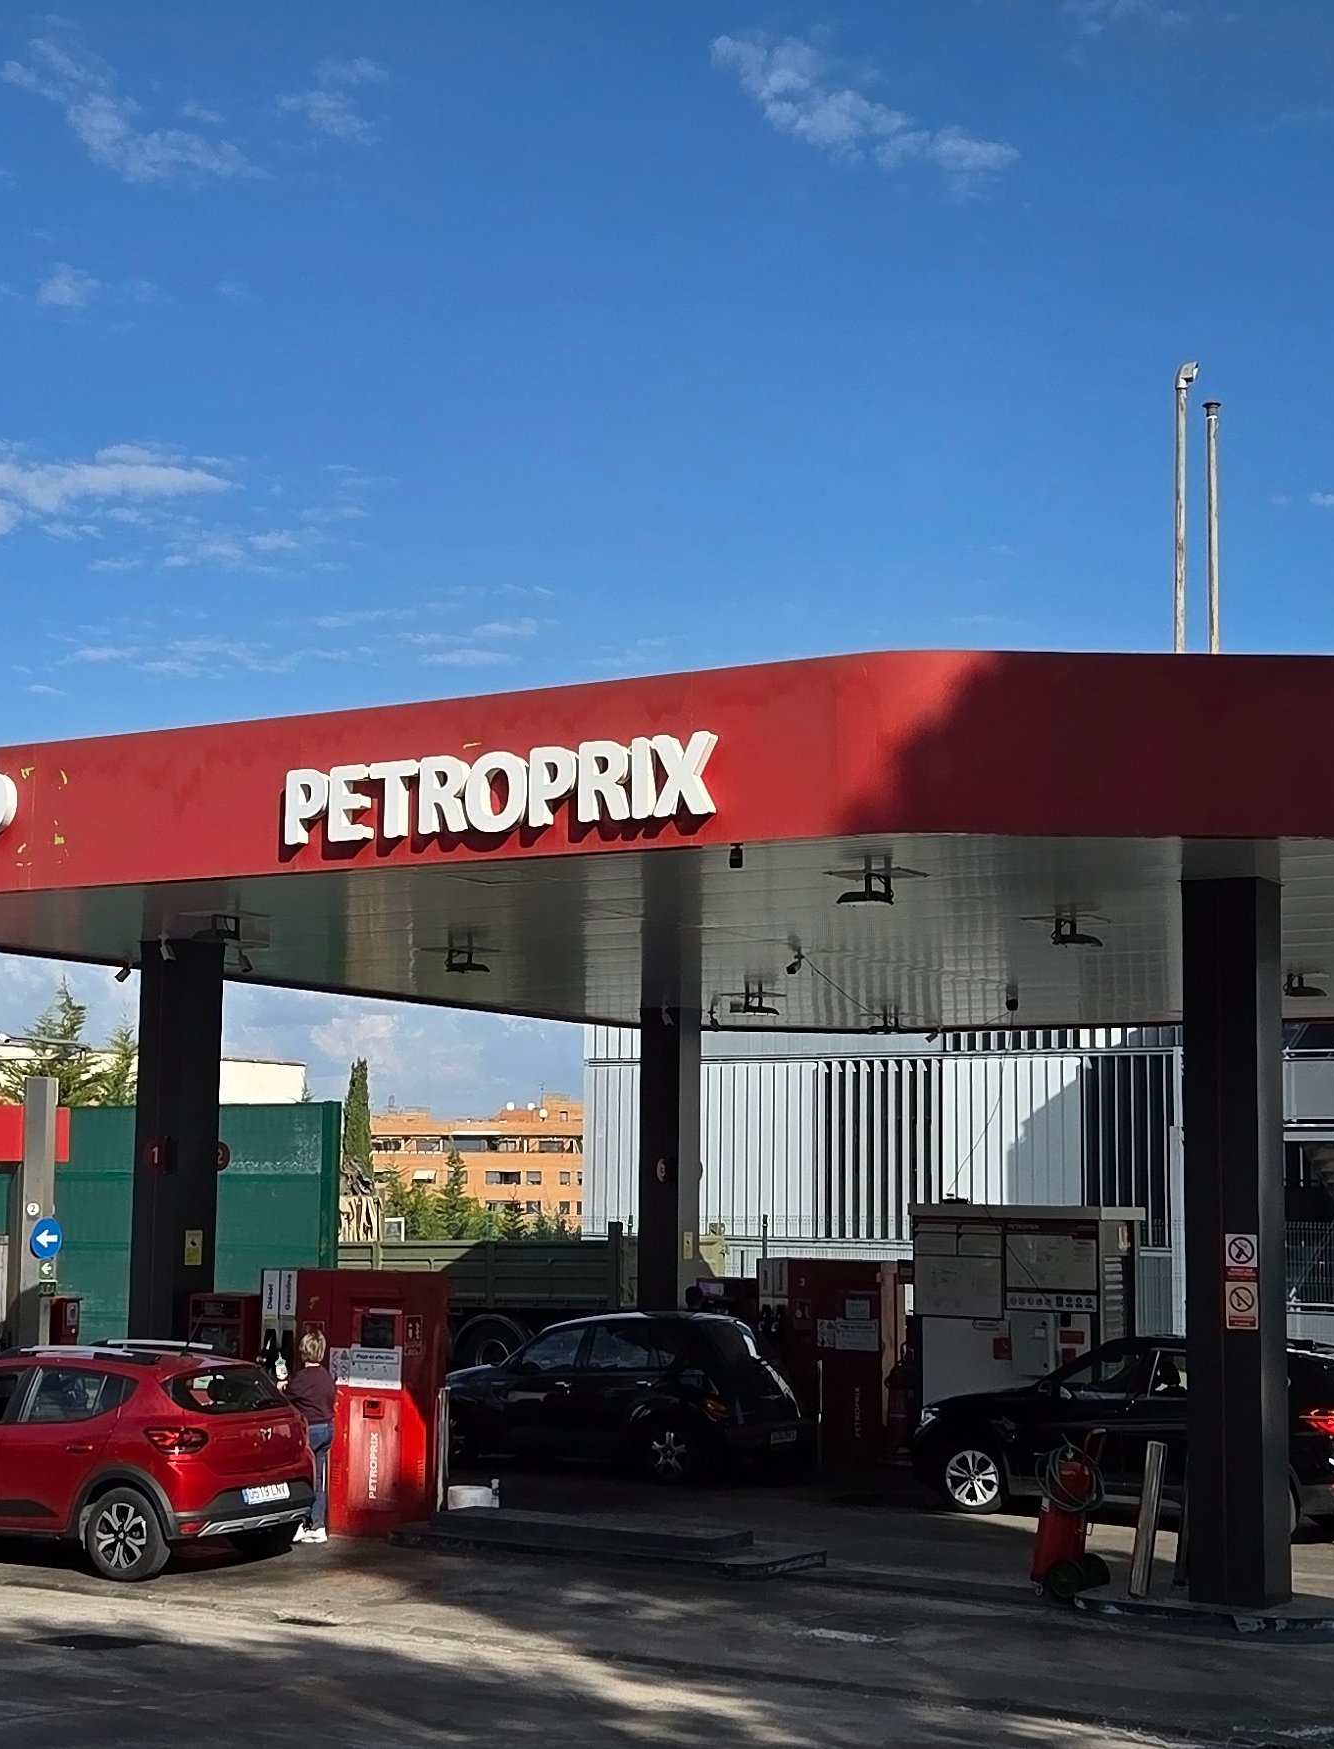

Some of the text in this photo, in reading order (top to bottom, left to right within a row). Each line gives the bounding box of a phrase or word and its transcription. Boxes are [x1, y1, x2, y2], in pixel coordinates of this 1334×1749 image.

[284, 730, 718, 847] PETROPRIX
[152, 1146, 159, 1164] 1
[368, 1432, 379, 1500] PETROPRIX
